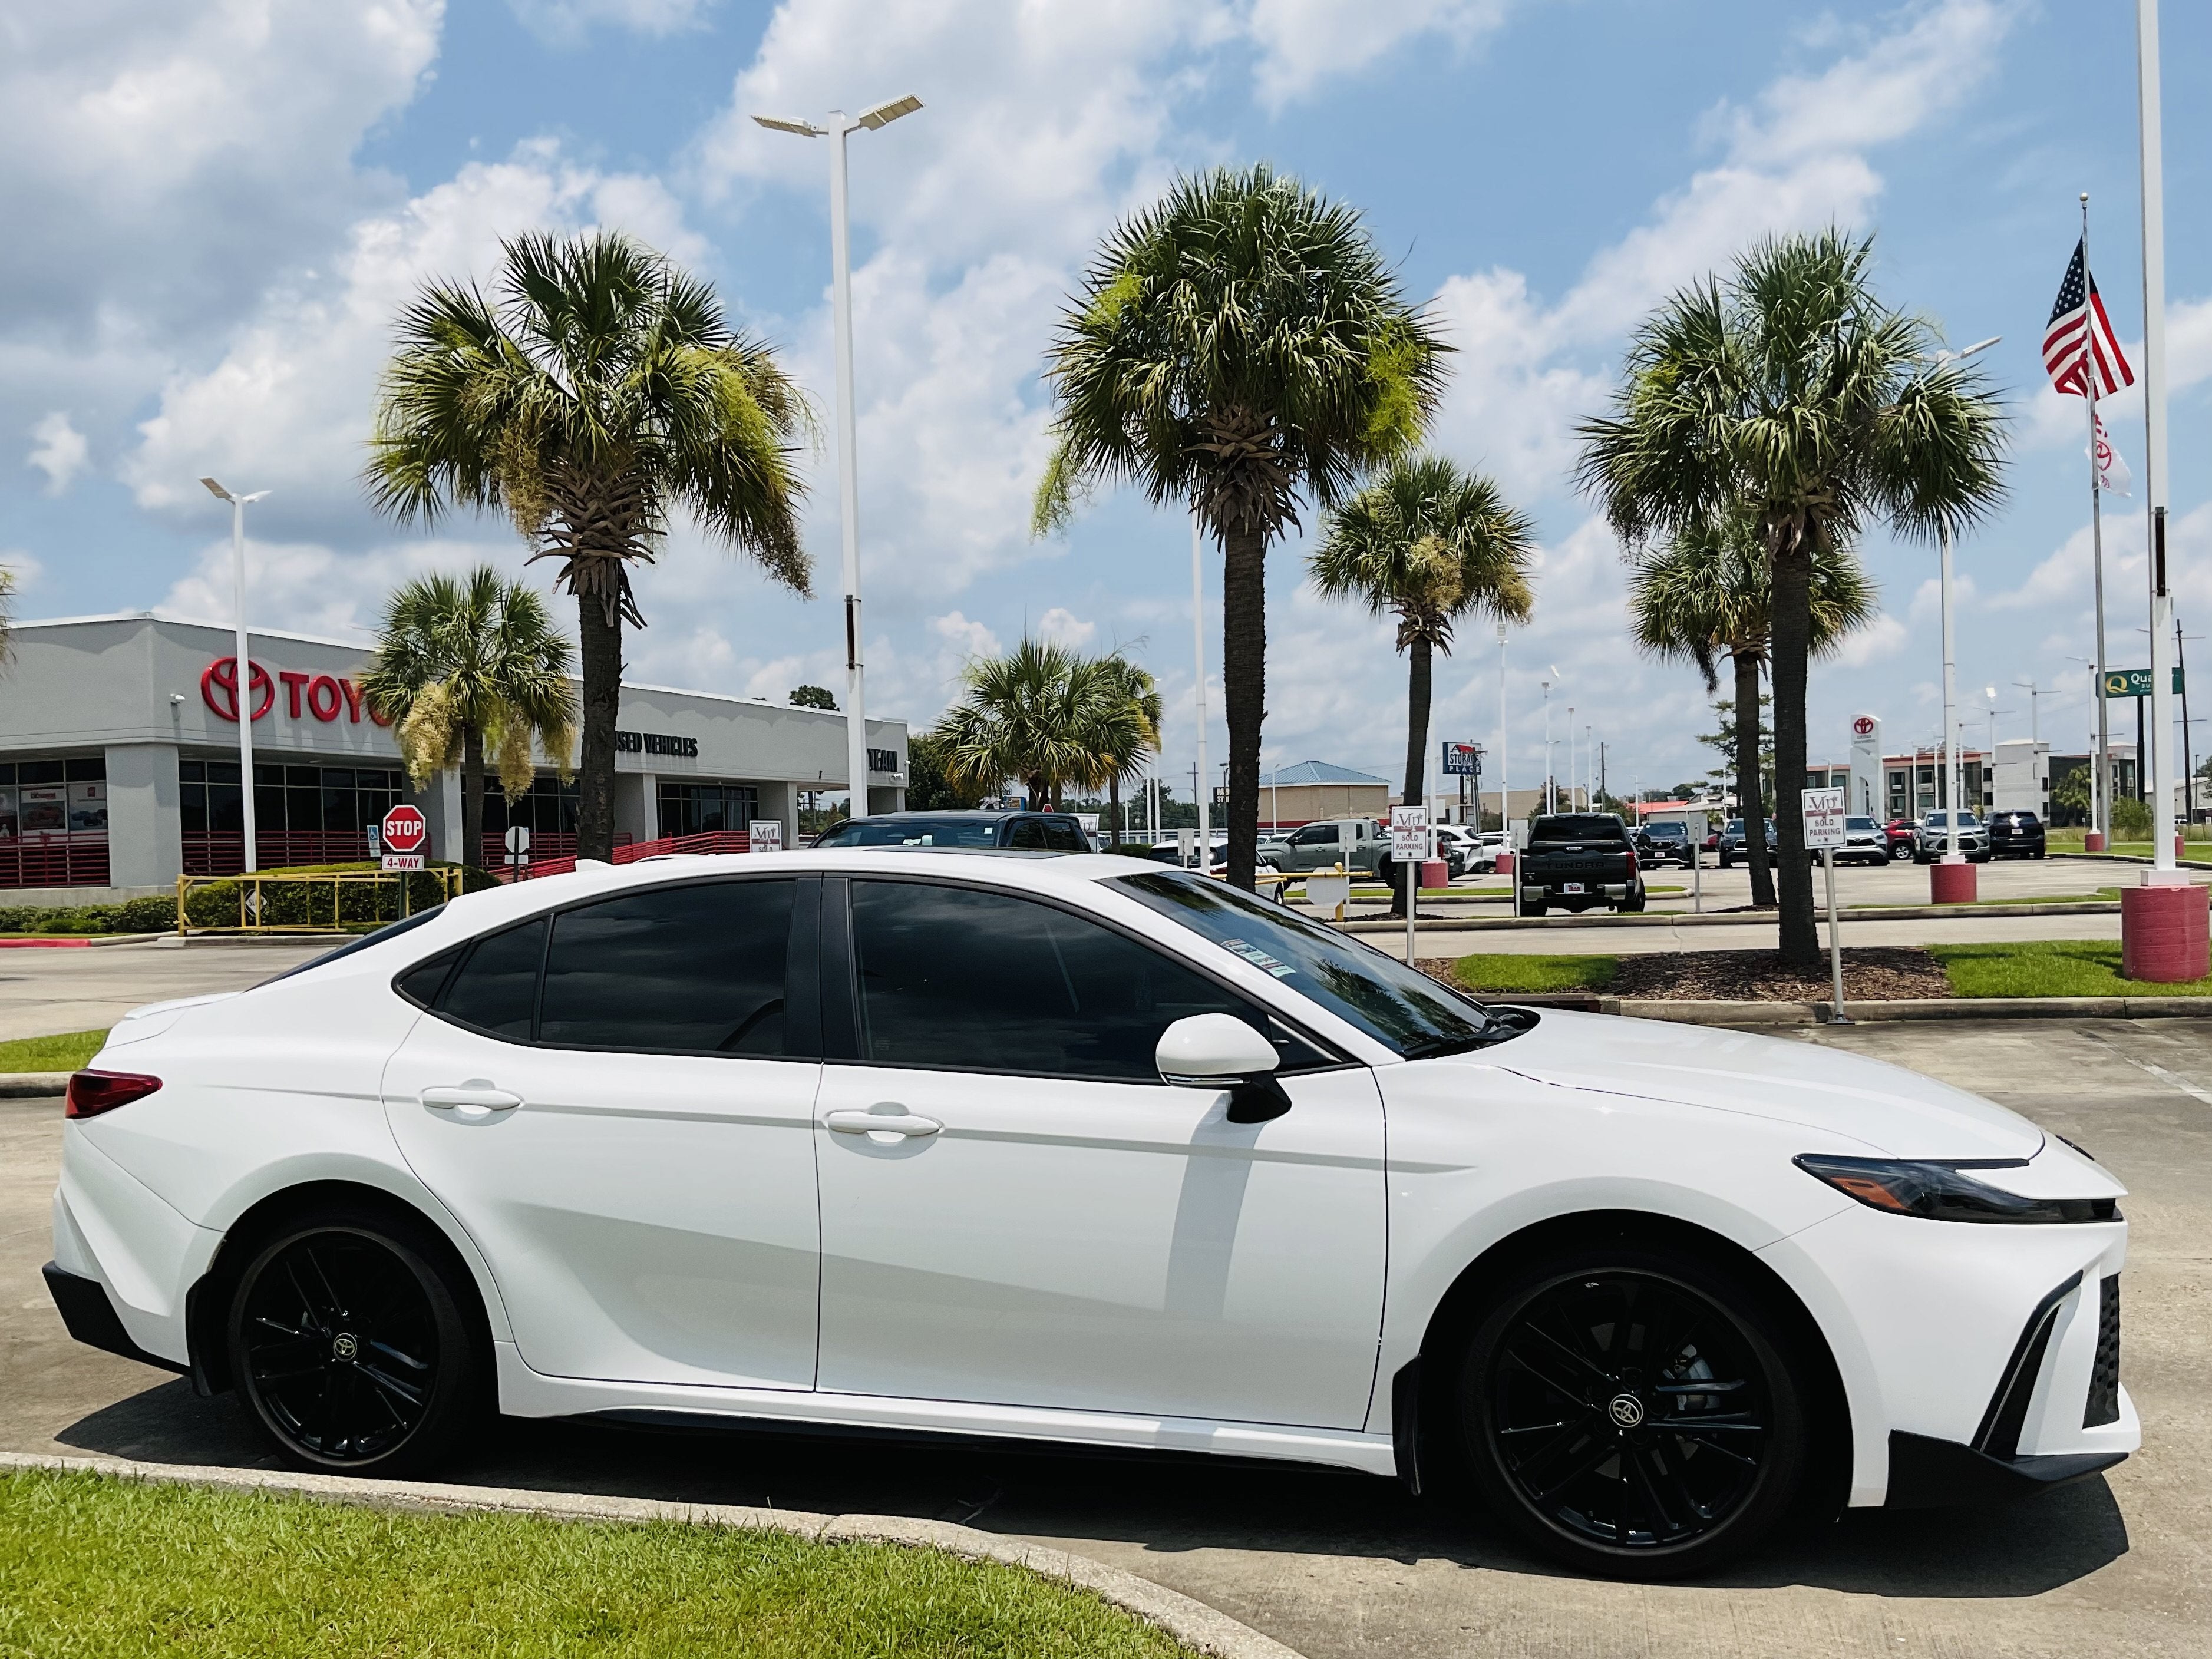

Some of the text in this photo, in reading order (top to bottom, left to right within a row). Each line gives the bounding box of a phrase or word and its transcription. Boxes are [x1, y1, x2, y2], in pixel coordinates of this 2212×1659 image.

[643, 733, 698, 756] VEHICLES
[867, 748, 897, 772] TEAM
[387, 819, 422, 837] STOP
[1815, 819, 1834, 827] SOLD
[1810, 828, 1841, 837] PARKING
[387, 858, 420, 868] 4-WAY
[1546, 861, 1604, 870] TUNDRA
